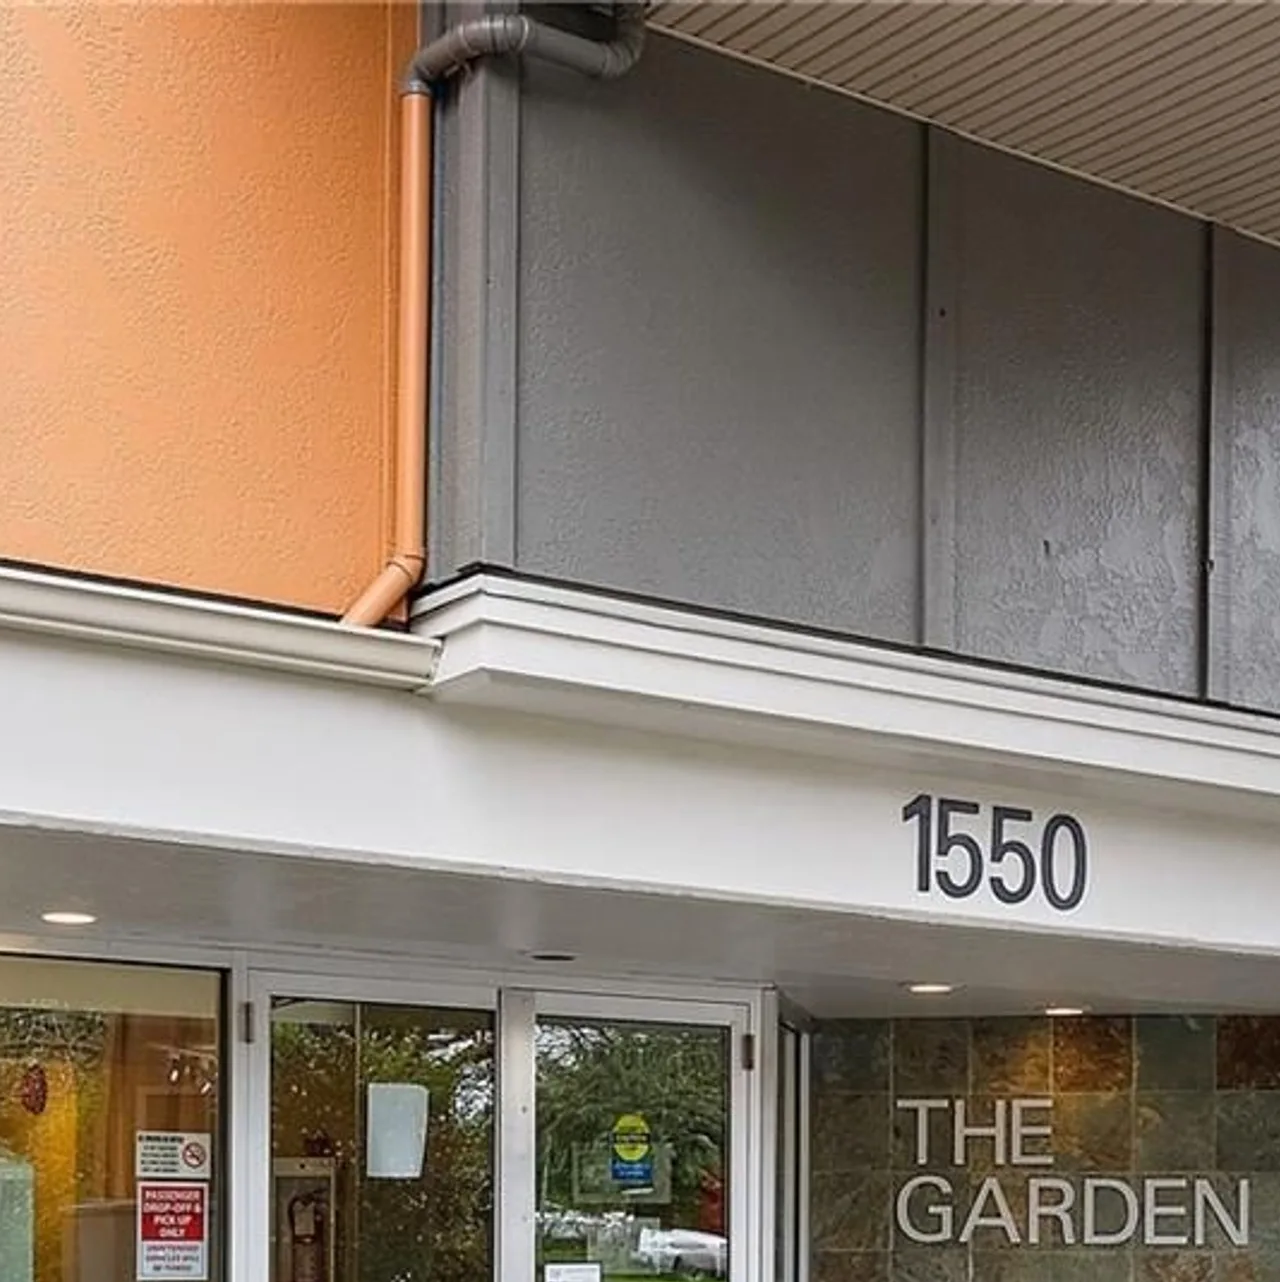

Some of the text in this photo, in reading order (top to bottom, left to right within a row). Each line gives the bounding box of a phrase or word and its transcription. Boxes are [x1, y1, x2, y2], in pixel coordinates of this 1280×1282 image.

[902, 795, 1088, 911] 1550
[895, 1099, 1054, 1165] THE
[145, 1190, 200, 1200] PASSENGER
[143, 1202, 192, 1213] DROP-OFF
[895, 1176, 1250, 1246] GARDEN
[153, 1215, 192, 1225] PICK UP
[158, 1227, 185, 1237] ONLY
